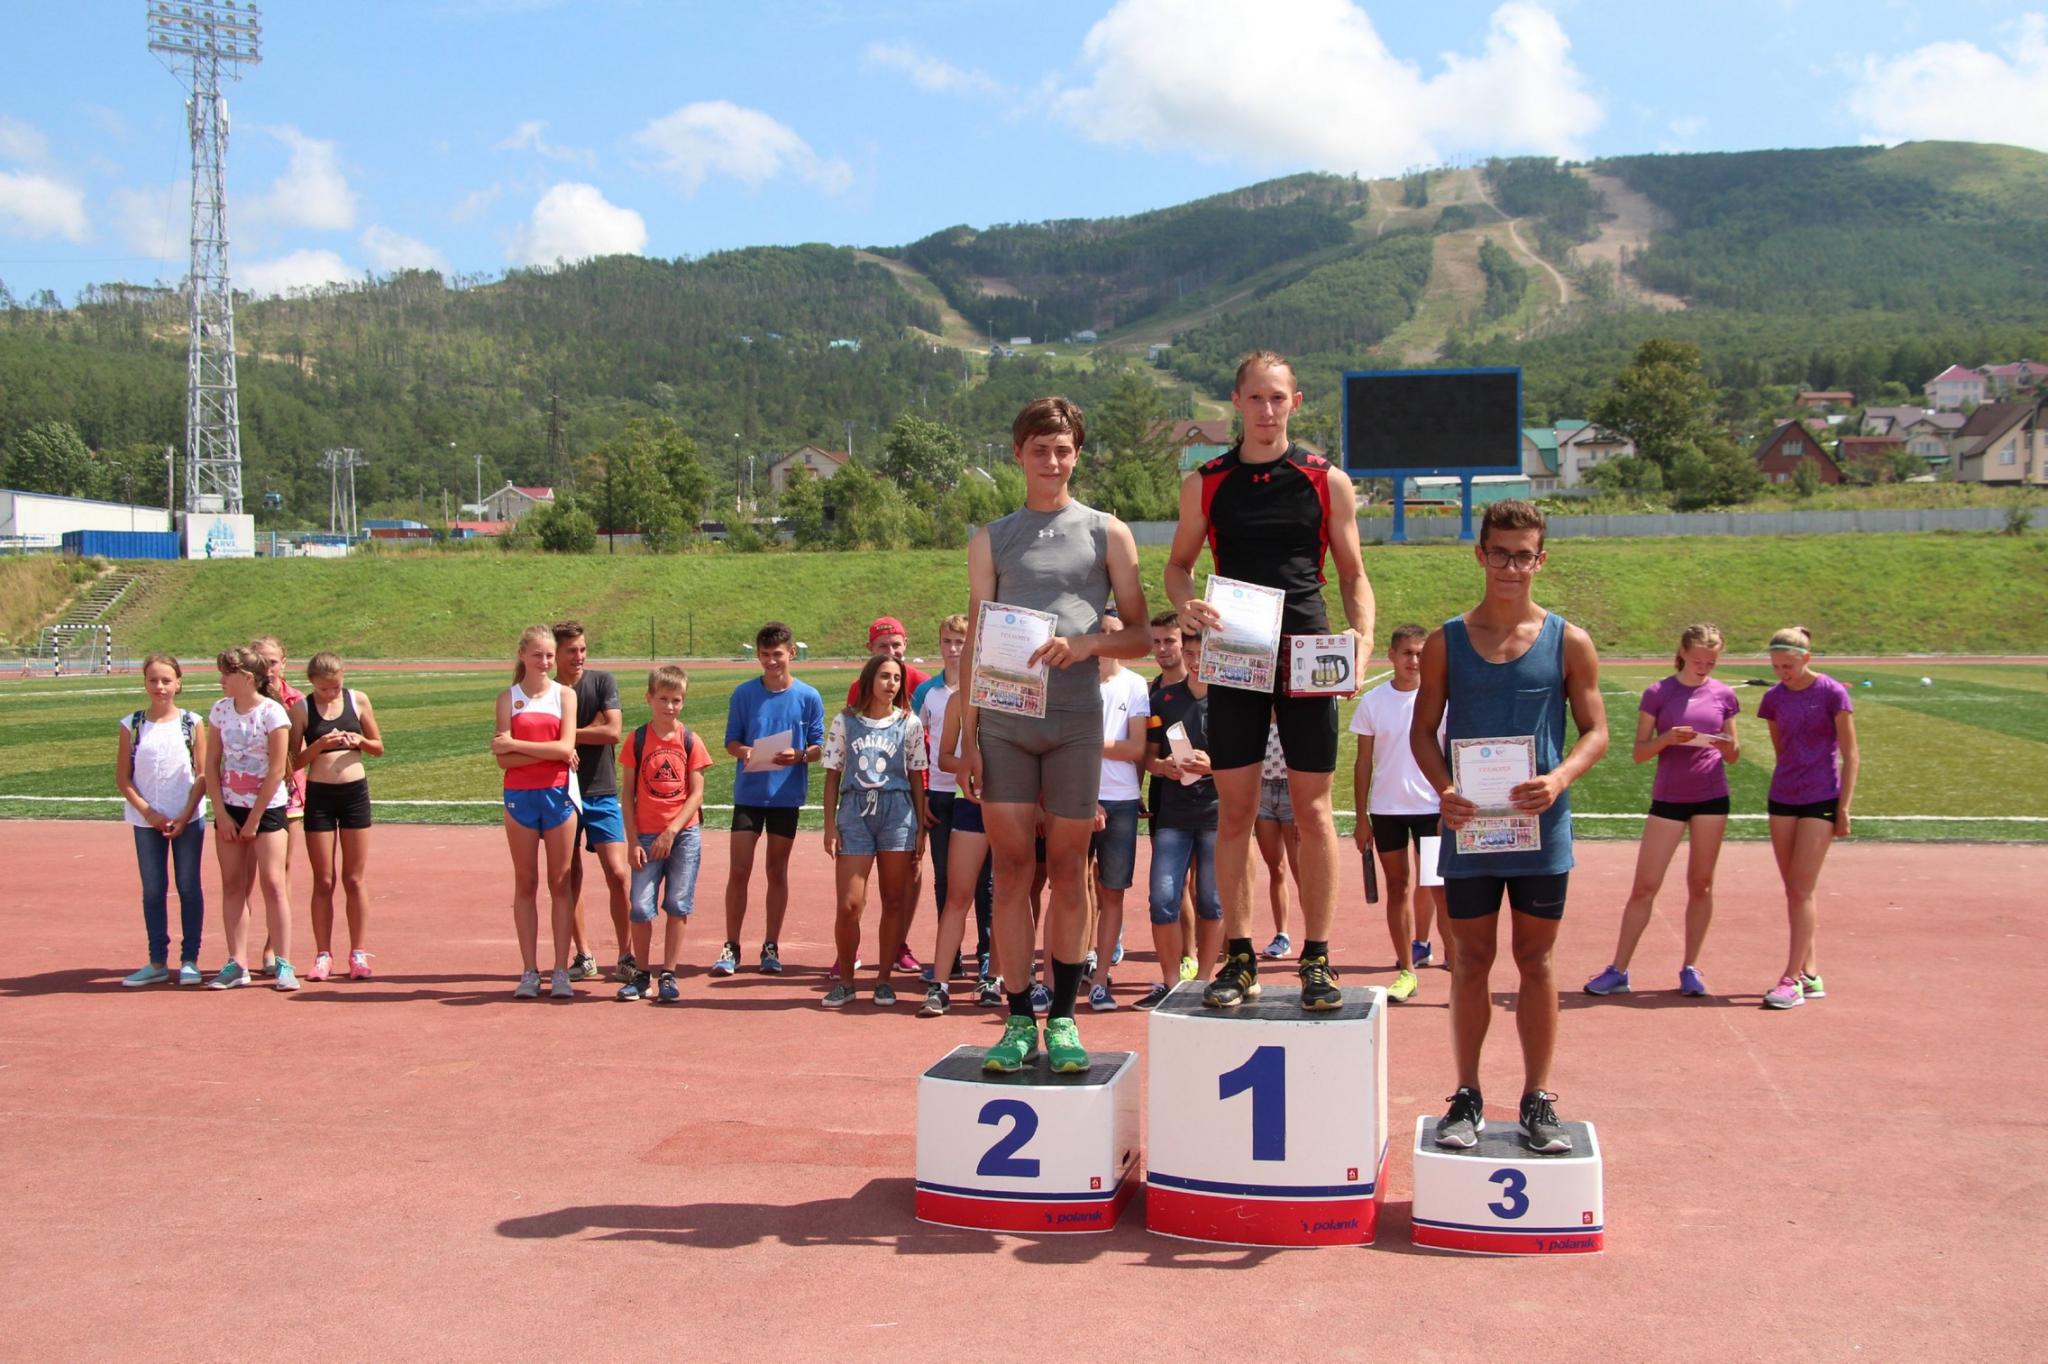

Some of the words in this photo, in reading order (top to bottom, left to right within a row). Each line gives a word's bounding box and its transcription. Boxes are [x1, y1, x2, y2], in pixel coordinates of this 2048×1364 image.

[1219, 1046, 1285, 1160] 1
[976, 1099, 1040, 1177] 2
[1488, 1168, 1529, 1219] 3
[1055, 1211, 1103, 1224] polanik
[1312, 1217, 1359, 1232] polanik
[1548, 1238, 1595, 1253] polanik
